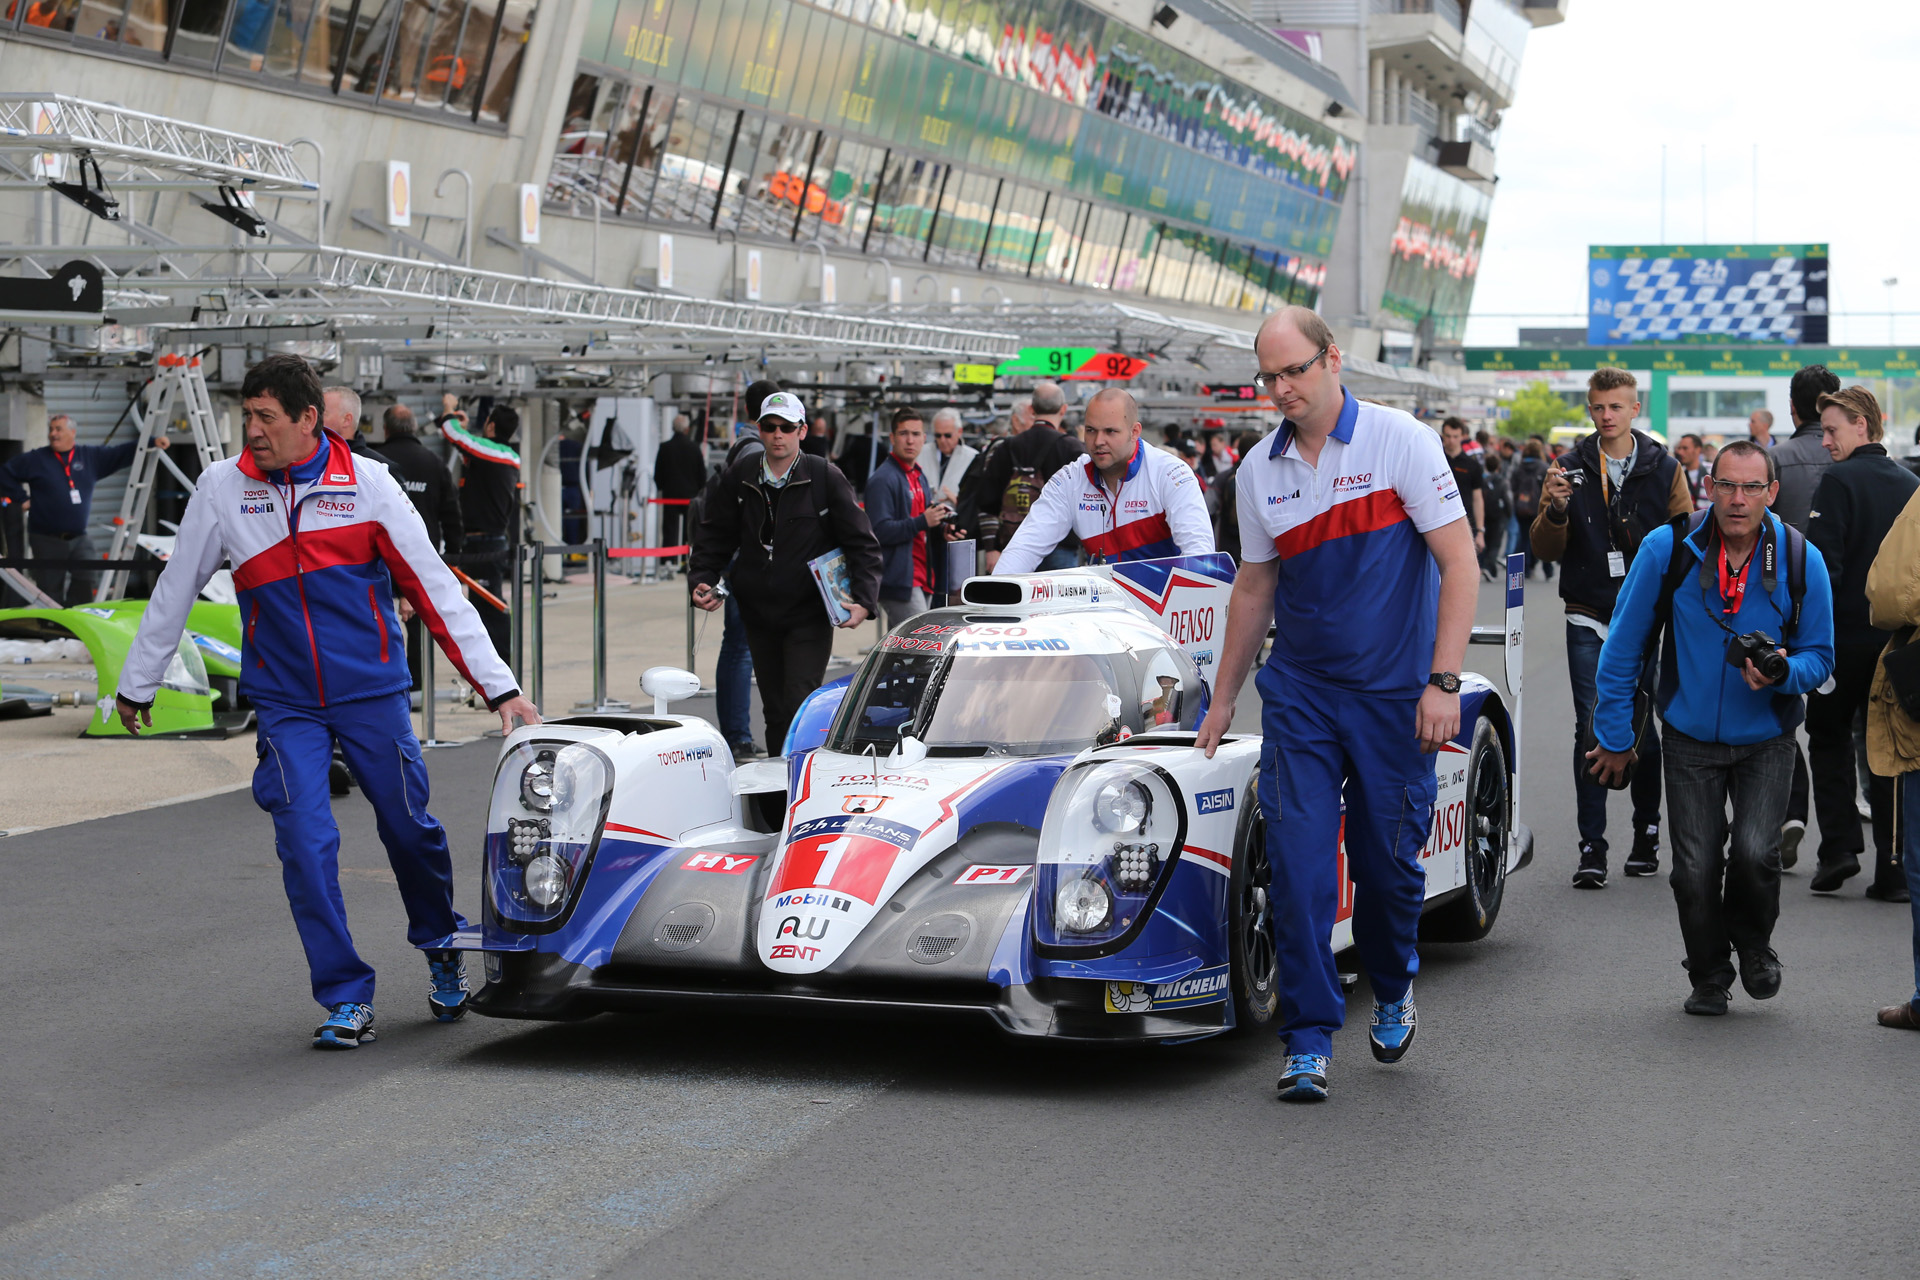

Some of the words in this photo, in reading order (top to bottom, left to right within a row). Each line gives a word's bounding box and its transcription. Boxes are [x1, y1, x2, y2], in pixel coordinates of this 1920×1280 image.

[624, 25, 674, 67] ROLEX
[741, 61, 783, 98] ROLEX
[1049, 352, 1073, 372] 91
[1107, 357, 1132, 377] 92
[1333, 472, 1372, 488] DENSO
[1350, 483, 1371, 491] HYBRID
[240, 503, 265, 514] Mobil
[316, 500, 355, 512] DENSO
[1079, 503, 1100, 511] Mobil
[1124, 501, 1148, 509] DENSO
[911, 625, 1028, 637] DENSO
[1170, 606, 1214, 645] DENSO
[881, 635, 943, 652] TOYOTA
[956, 638, 1071, 652] HYBRID
[657, 750, 685, 767] TOYOTA
[686, 744, 713, 762] HYBRID
[701, 761, 707, 781] 1
[838, 774, 930, 787] TOYOTA
[1200, 792, 1233, 811] AISIN
[856, 821, 912, 842] MANS
[687, 853, 753, 871] HY
[812, 836, 853, 886] 1
[966, 867, 1019, 881] P1
[775, 893, 829, 909] Mobil
[769, 944, 822, 962] ZENT
[1153, 972, 1229, 999] MICHELIN
